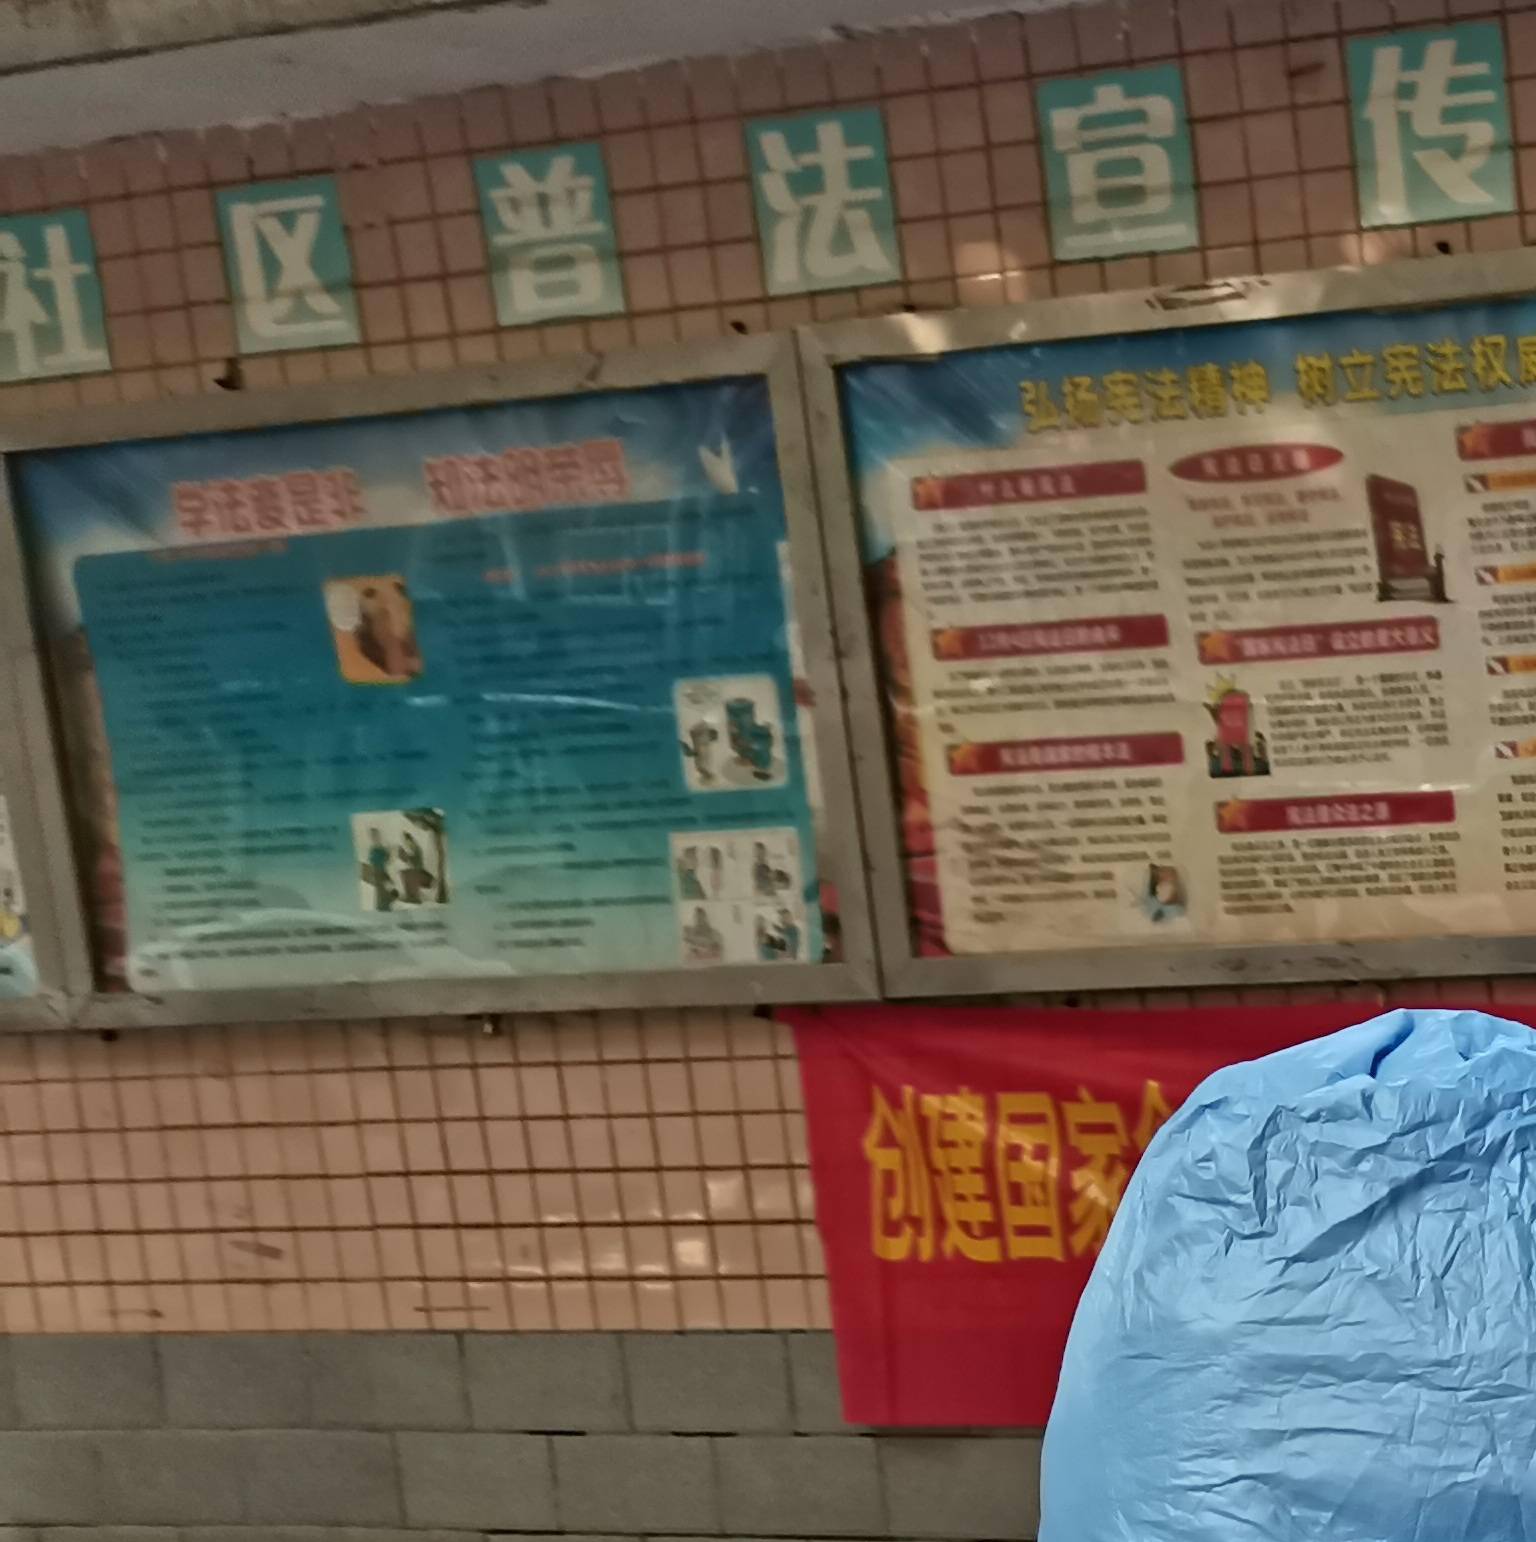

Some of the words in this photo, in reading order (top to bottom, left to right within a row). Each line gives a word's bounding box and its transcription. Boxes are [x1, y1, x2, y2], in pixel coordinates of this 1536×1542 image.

[1021, 361, 1271, 433] 弘扬宪法精神
[863, 1078, 1172, 1264] 创建国家
